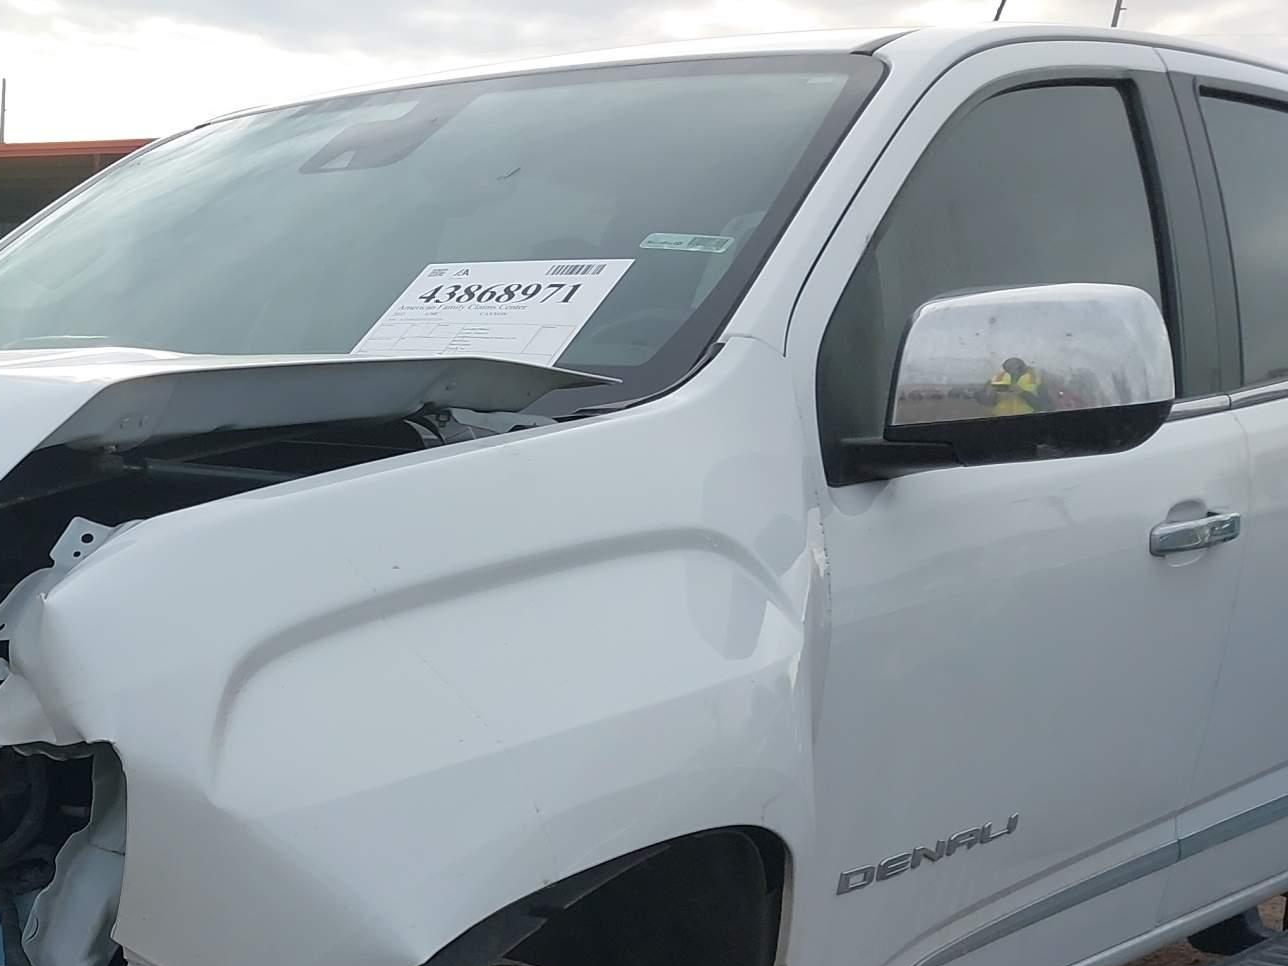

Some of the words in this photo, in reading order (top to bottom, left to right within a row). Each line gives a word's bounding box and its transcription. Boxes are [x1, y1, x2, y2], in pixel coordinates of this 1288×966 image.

[418, 283, 582, 304] 43868971
[438, 304, 465, 312] Family
[836, 812, 1019, 895] DENALI
